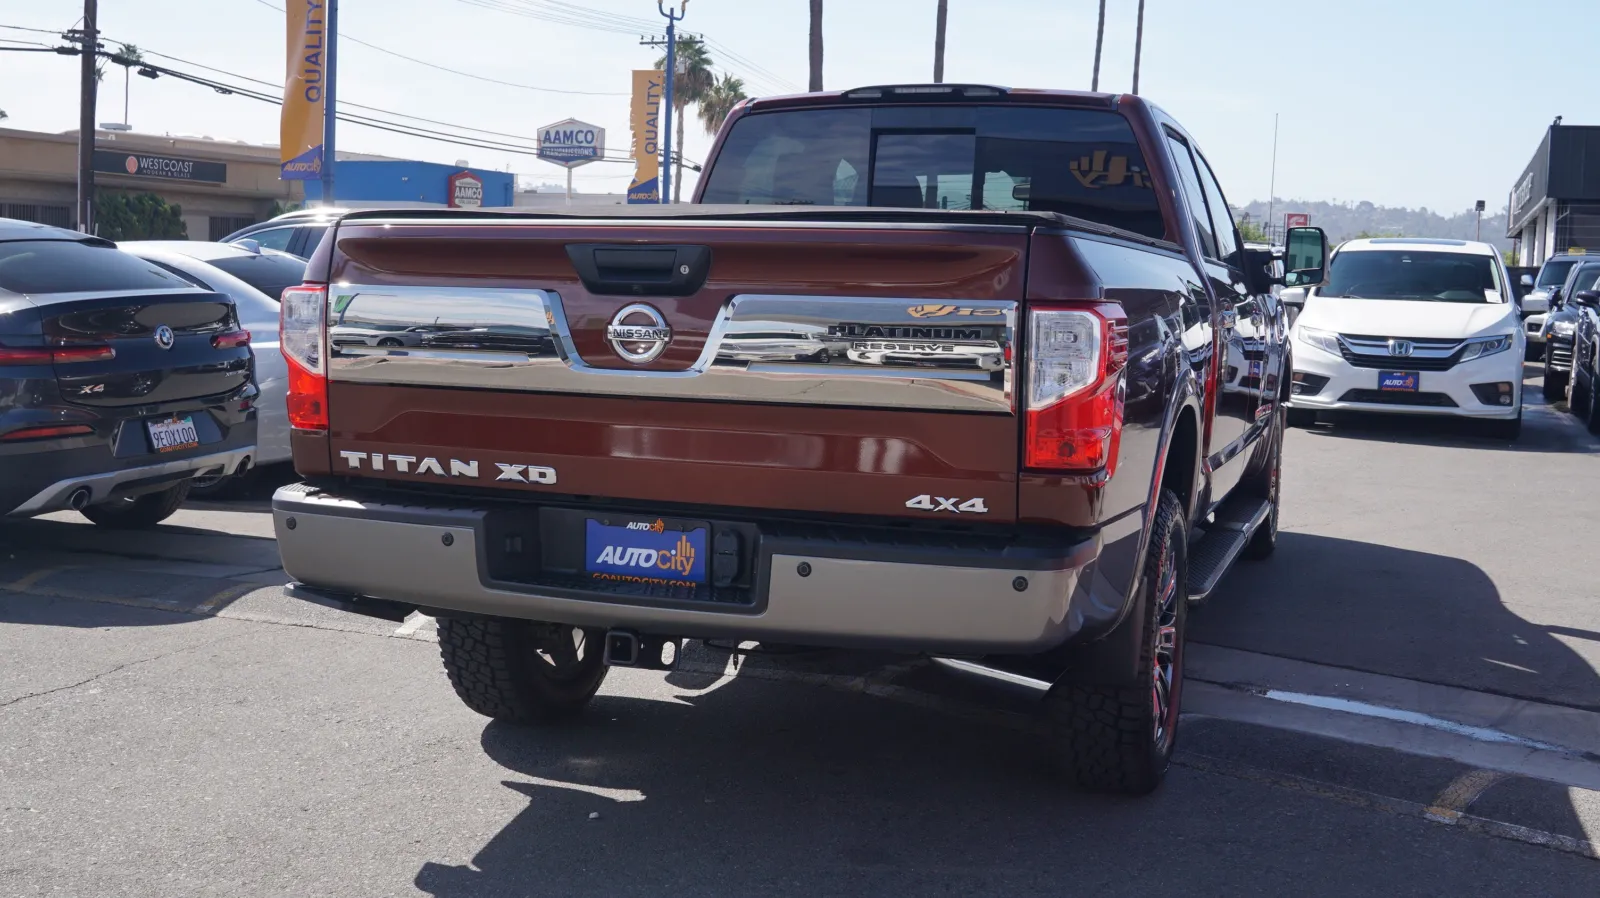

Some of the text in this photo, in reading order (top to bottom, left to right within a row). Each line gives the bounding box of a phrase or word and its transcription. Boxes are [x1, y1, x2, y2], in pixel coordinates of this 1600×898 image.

[304, 0, 322, 103] QUALITY
[542, 129, 595, 145] AAMCO
[140, 157, 194, 173] WESTCOAST
[455, 187, 483, 199] AAMCO
[613, 328, 662, 339] NISSAN
[828, 325, 982, 340] PLATINUM
[854, 341, 955, 353] RESERVE
[78, 383, 104, 394] X4
[340, 450, 558, 485] TITAN XD
[592, 572, 697, 588] GOAUTOCITYCOM
